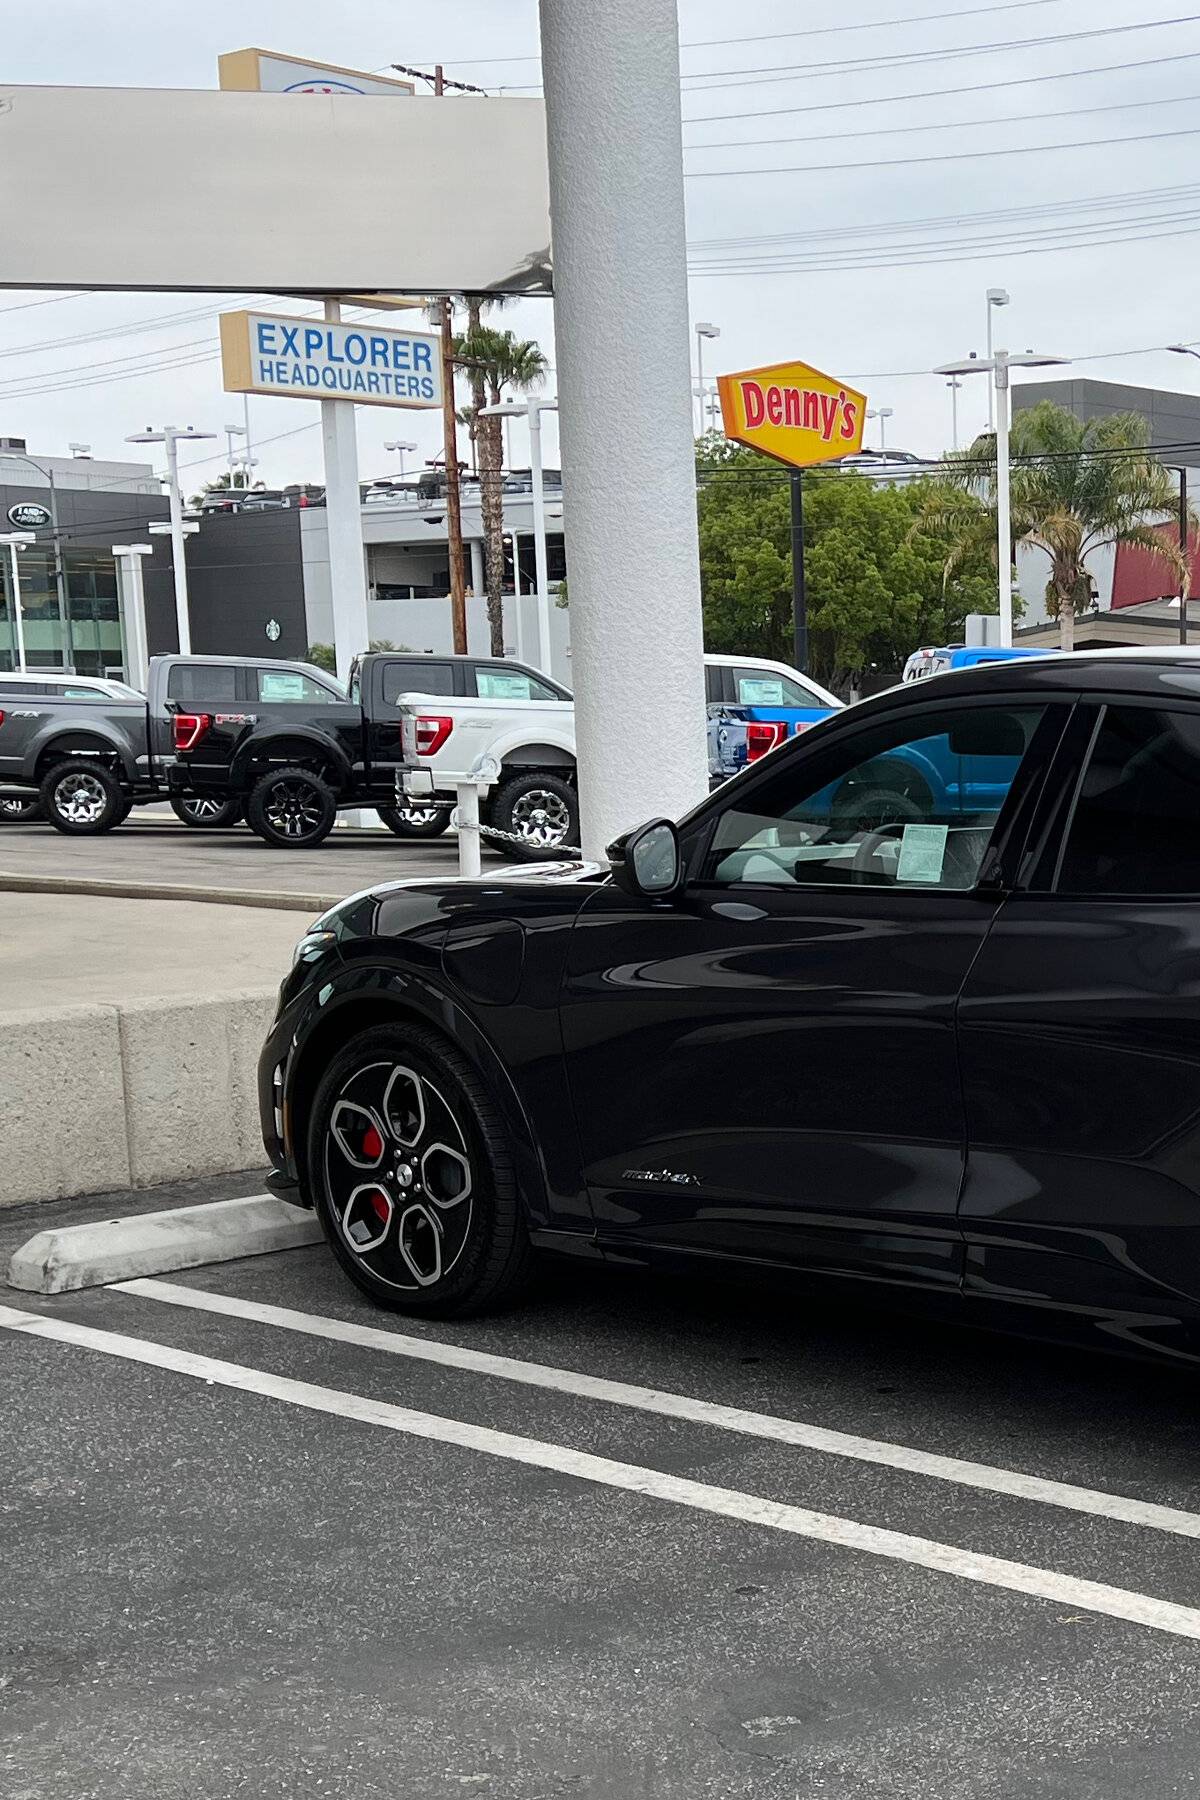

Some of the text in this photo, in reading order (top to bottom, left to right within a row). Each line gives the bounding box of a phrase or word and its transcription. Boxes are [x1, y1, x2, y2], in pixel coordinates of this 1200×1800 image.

[257, 323, 432, 373] EXPLORER
[259, 360, 434, 399] HEADQUARTERS
[739, 381, 857, 440] Denny's
